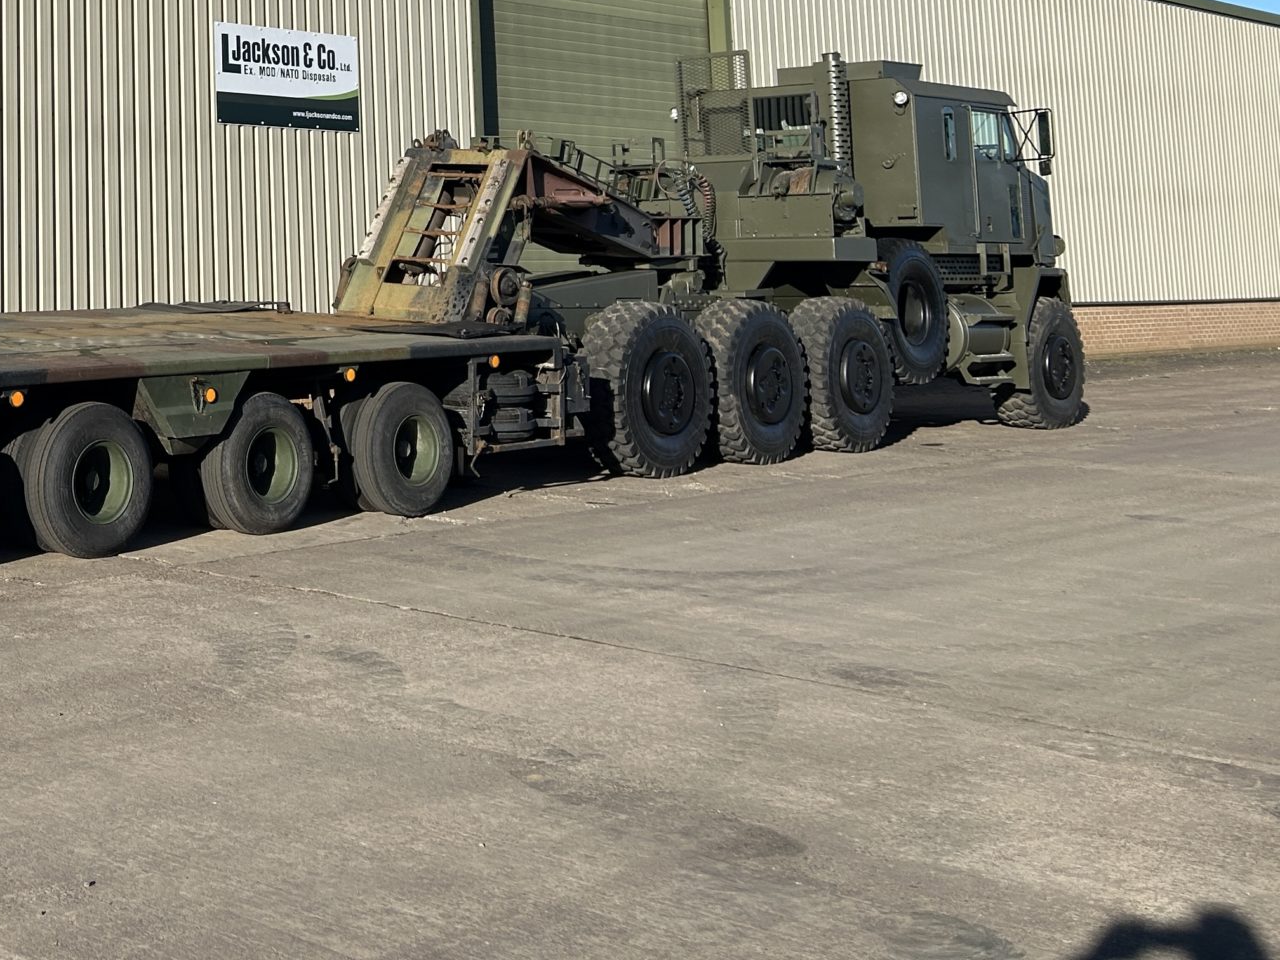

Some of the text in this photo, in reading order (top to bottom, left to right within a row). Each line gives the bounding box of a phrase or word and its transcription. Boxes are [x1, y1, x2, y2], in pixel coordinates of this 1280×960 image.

[303, 42, 314, 68] &
[317, 44, 339, 71] Co.
[243, 65, 256, 75] Ex.
[302, 69, 336, 83] Disposals
